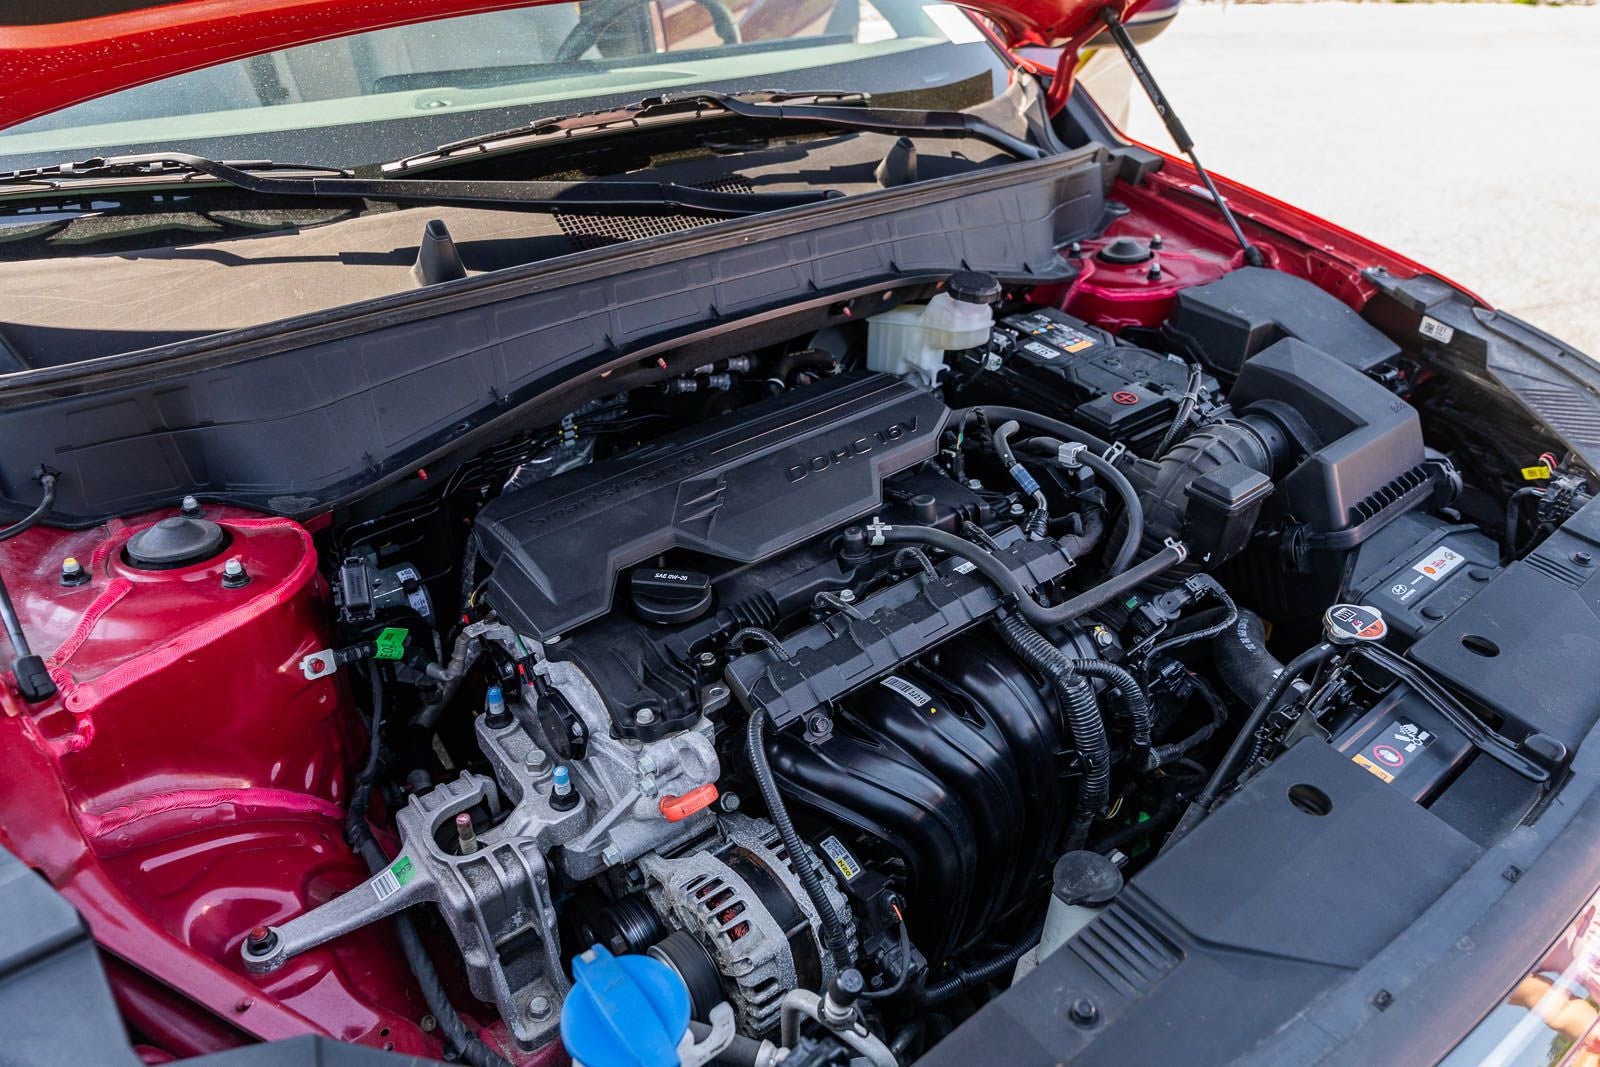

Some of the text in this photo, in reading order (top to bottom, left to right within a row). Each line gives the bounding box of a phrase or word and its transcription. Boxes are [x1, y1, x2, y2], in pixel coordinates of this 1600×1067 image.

[784, 415, 919, 484] DOHC 16V
[837, 859, 852, 877] N20
